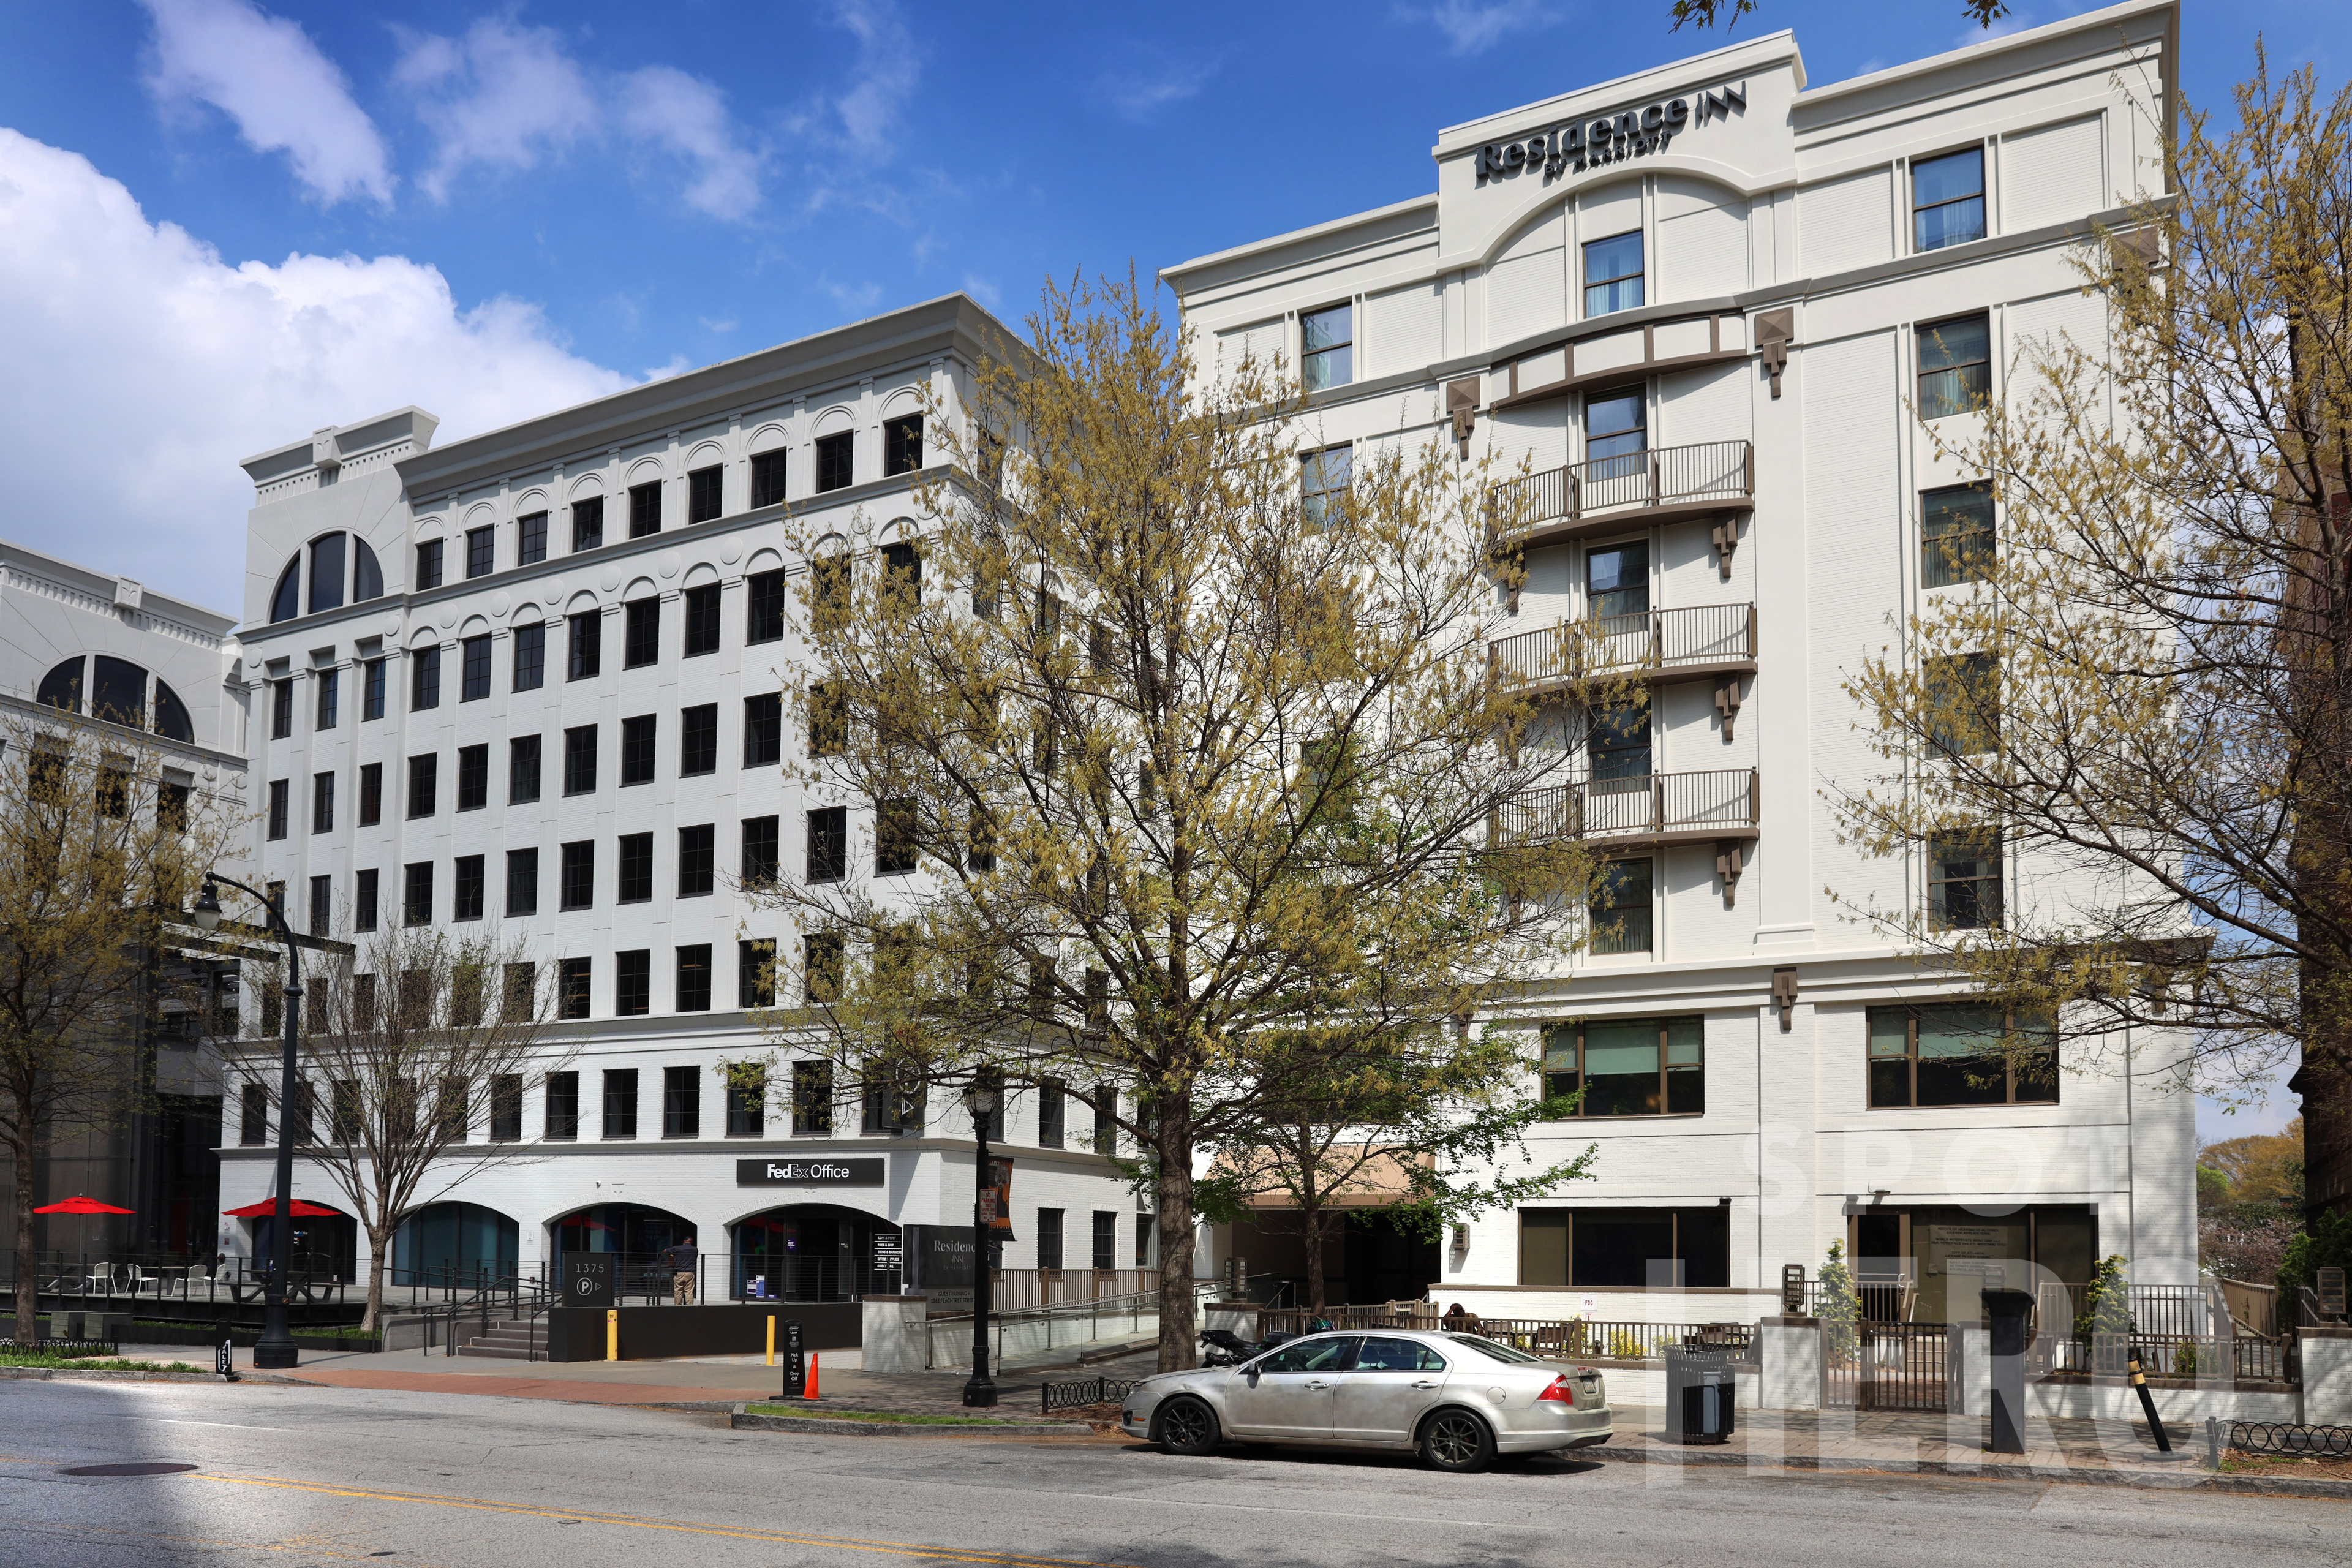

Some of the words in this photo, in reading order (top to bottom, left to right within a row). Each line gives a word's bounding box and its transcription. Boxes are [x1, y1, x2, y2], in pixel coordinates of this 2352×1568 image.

[1476, 99, 1688, 178] Residence
[1696, 80, 1747, 121] INN
[1544, 159, 1566, 178] BY
[1573, 130, 1672, 172] MARRIOTT
[767, 1163, 809, 1178] FedEx
[810, 1164, 850, 1178] Office
[934, 1240, 976, 1253] Residenc
[576, 1264, 604, 1273] 1375
[582, 1281, 589, 1292] P
